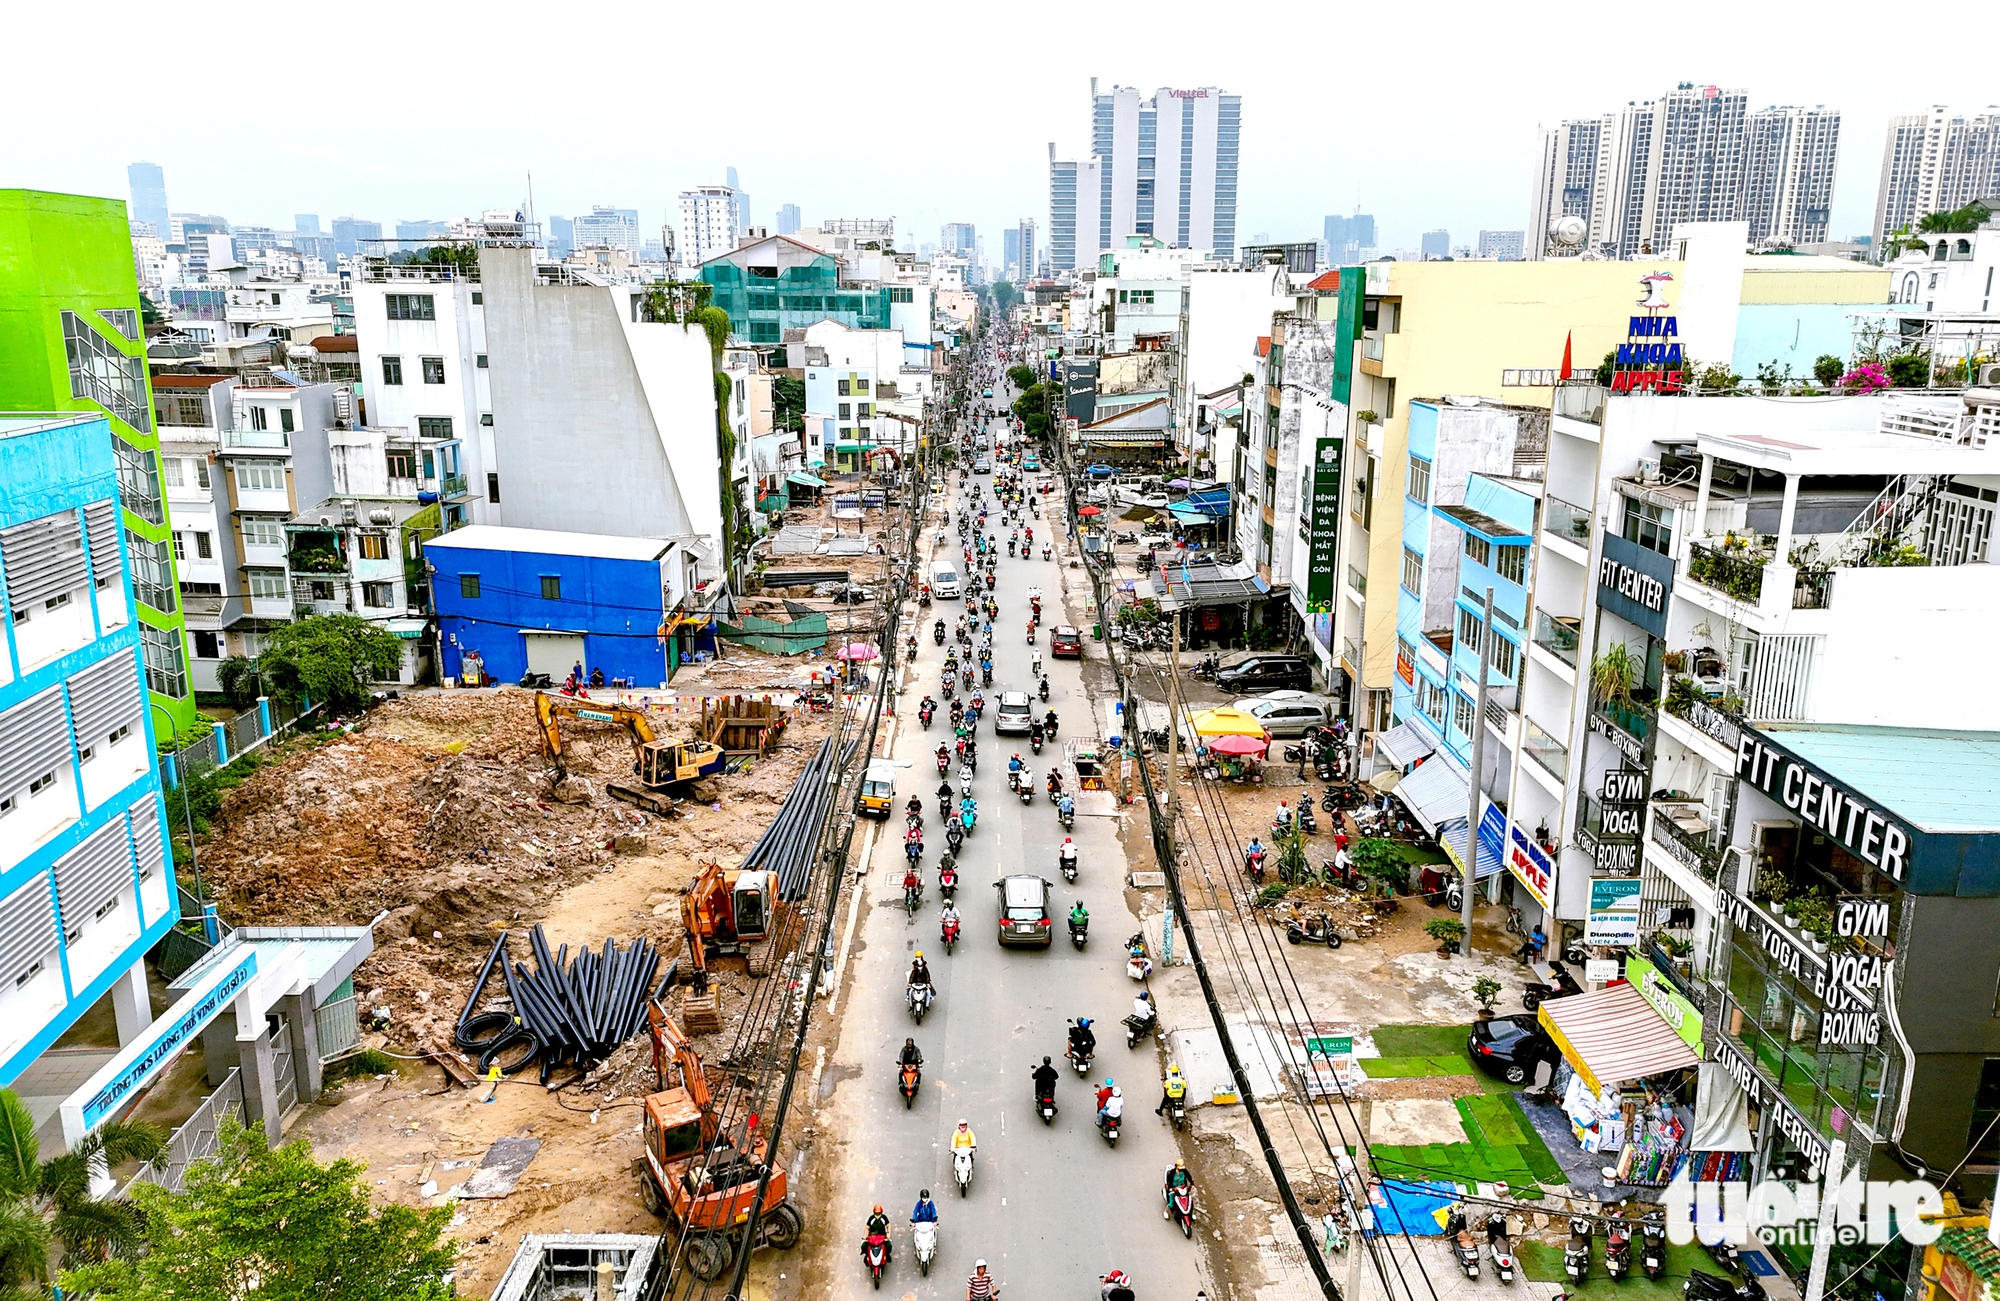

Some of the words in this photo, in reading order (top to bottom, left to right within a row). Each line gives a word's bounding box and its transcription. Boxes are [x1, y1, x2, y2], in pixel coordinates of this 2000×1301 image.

[1168, 89, 1209, 98] viettel
[1629, 316, 1678, 336] NHA
[1617, 343, 1683, 364] KHOA
[1611, 371, 1684, 391] APPLE
[1315, 493, 1337, 503] BỆNH
[1316, 505, 1335, 515] VIỆN
[1313, 563, 1331, 573] GÒN
[1600, 557, 1619, 588] FIT
[1618, 565, 1663, 612] CENTER
[1590, 714, 1607, 738] GYM
[1612, 731, 1641, 762] BOXING
[1605, 775, 1643, 799] GYM
[1736, 733, 1780, 793] FIT
[1783, 762, 1908, 881] CENTER
[1602, 810, 1639, 834] YOGA
[1576, 831, 1596, 859] YOGA
[1597, 844, 1637, 868] BOXING
[1718, 888, 1749, 932] GYM
[1762, 924, 1800, 978] YOGA
[1838, 903, 1889, 937] GYM
[1831, 955, 1882, 989] YOGA
[1641, 973, 1684, 1026] EVERON
[97, 1076, 132, 1112] TRƯỜNG
[131, 1055, 154, 1082] THCS
[195, 998, 217, 1022] VINH
[239, 967, 248, 985] 2)
[1821, 1012, 1879, 1044] BOXING
[1171, 1082, 1182, 1090] be
[1713, 1037, 1760, 1105] ZUMBA
[1771, 1101, 1829, 1176] AEROBI
